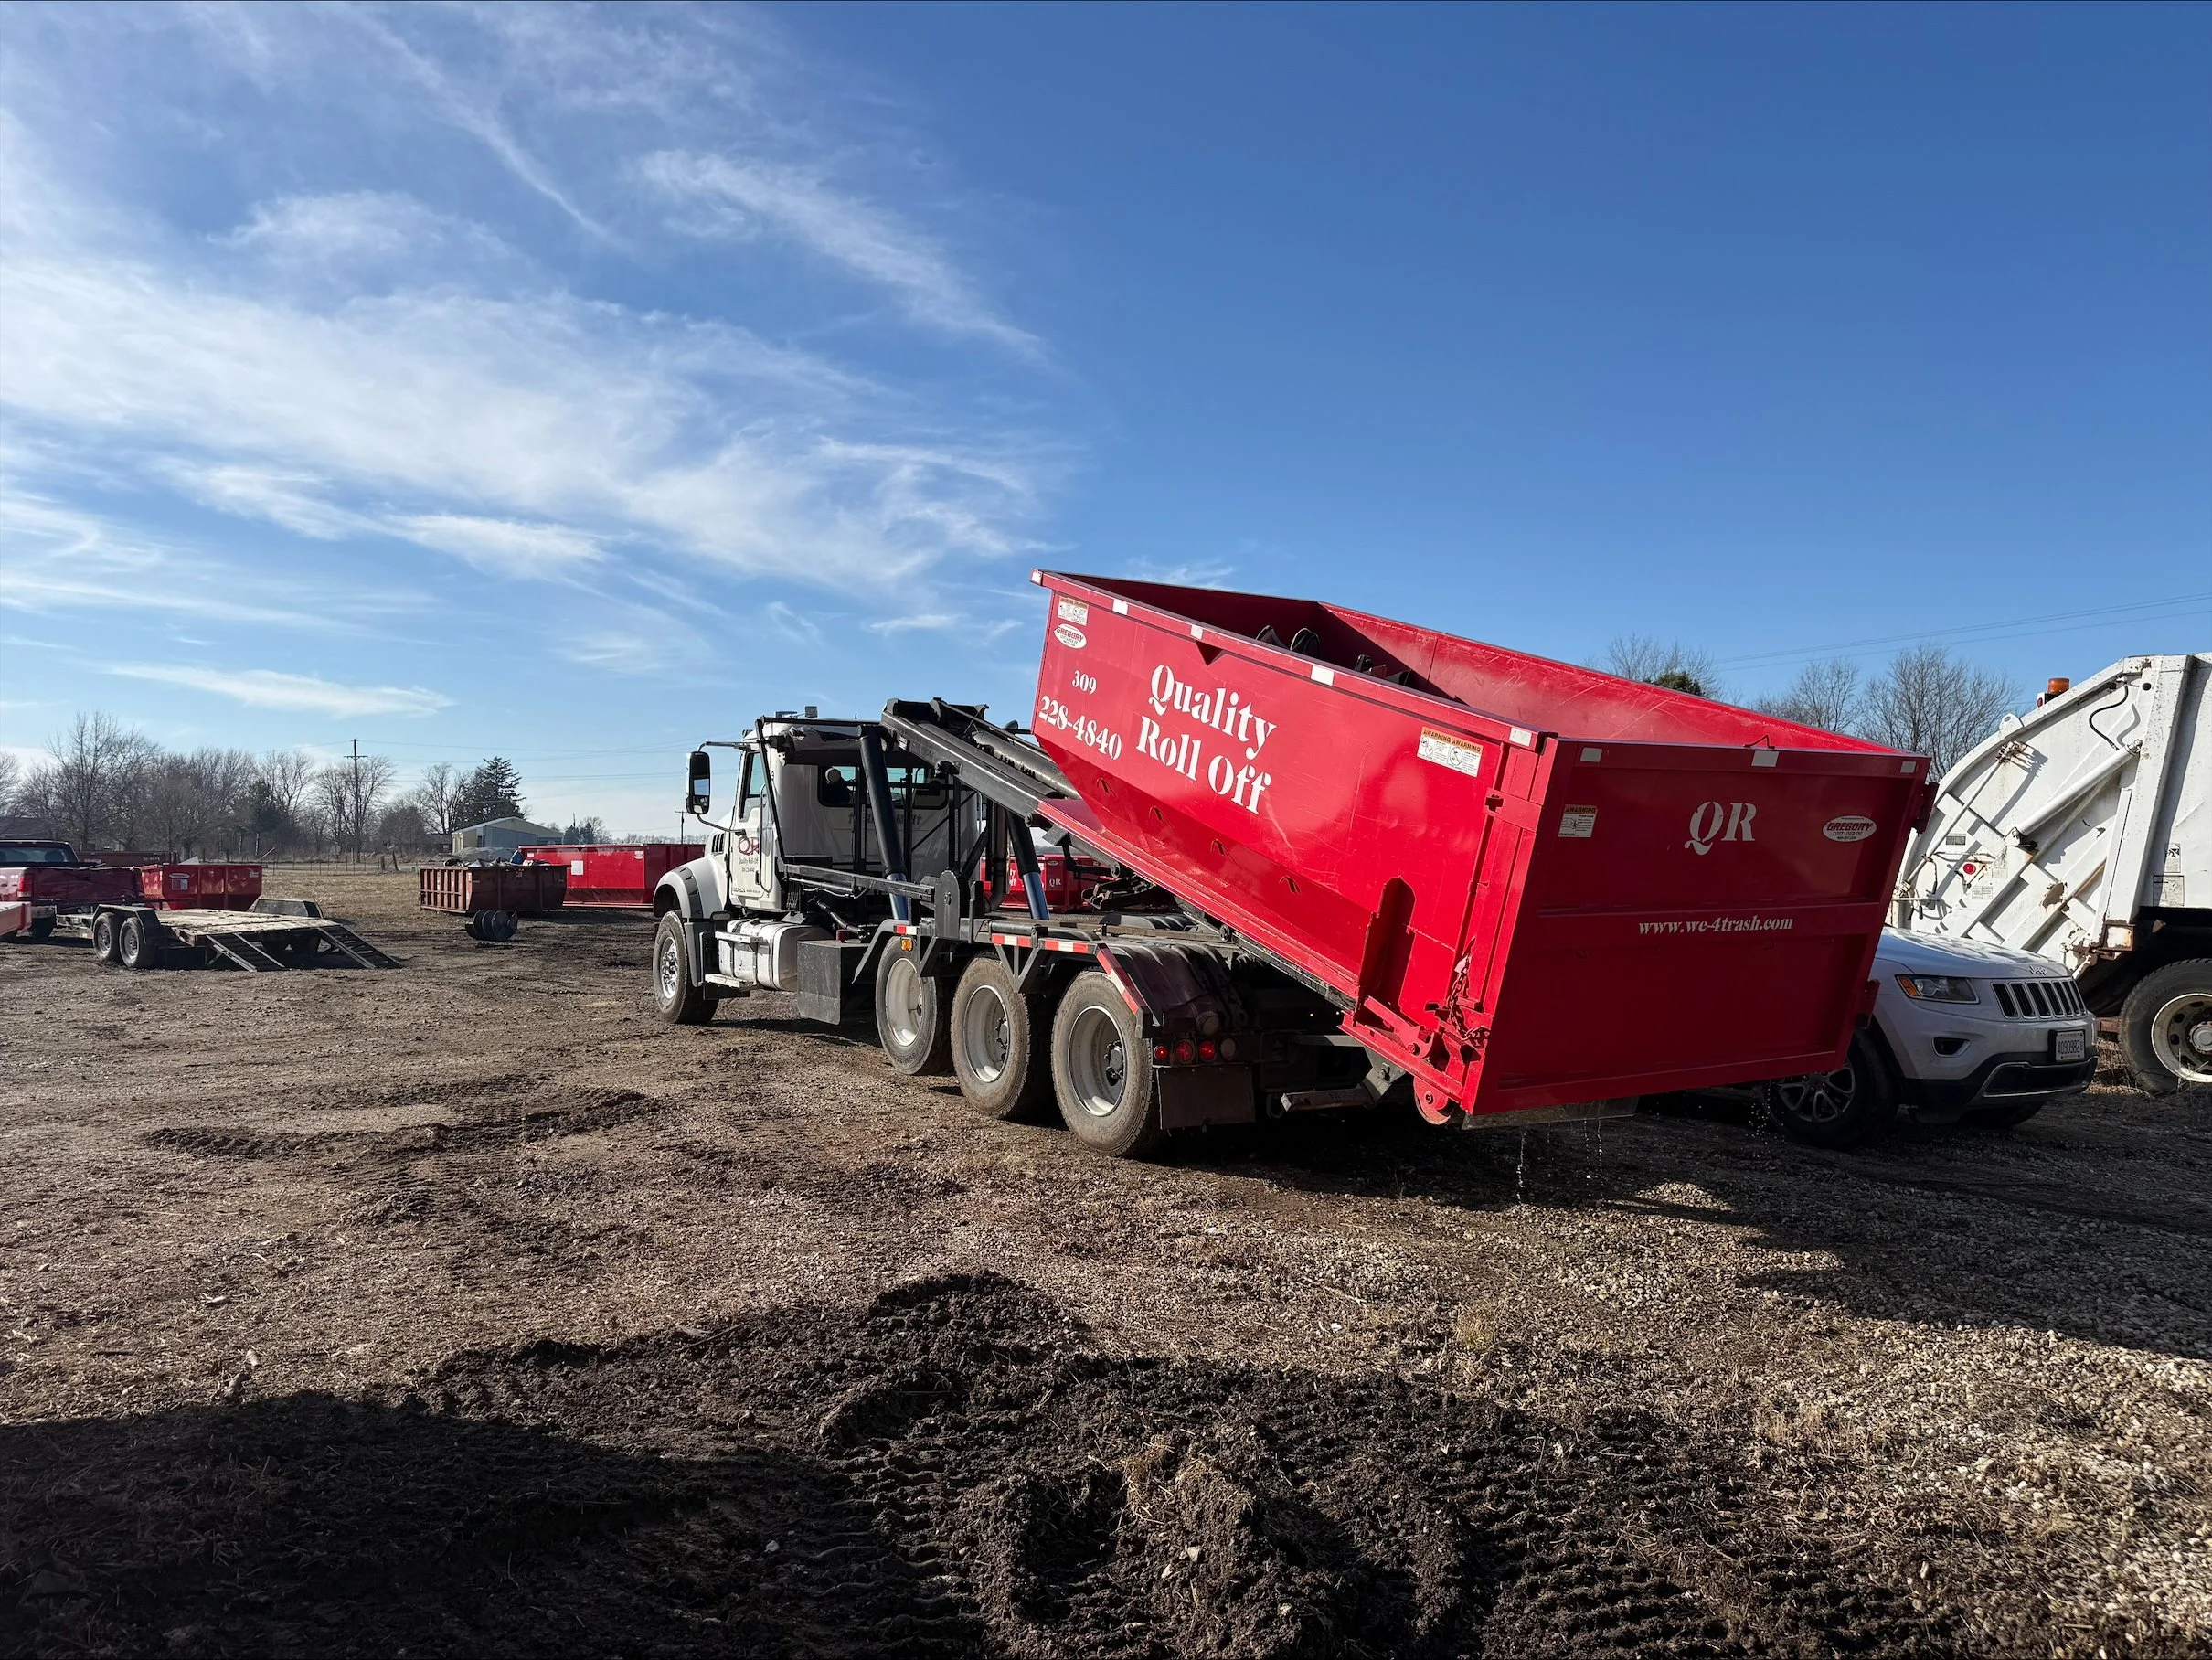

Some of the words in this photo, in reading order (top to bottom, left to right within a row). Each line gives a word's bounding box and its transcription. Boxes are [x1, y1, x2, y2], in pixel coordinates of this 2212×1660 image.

[1056, 626, 1084, 643] GREGORY
[1071, 670, 1097, 695] 309
[1148, 665, 1278, 761] Quality
[1038, 695, 1122, 761] 228-4840
[1427, 730, 1452, 743] WARNING
[1455, 740, 1481, 752] WARNING
[1135, 715, 1202, 782] Roll
[1207, 754, 1272, 815] Off
[1684, 801, 1757, 856] QR
[1826, 823, 1874, 831] GREGORY
[1048, 878, 1062, 888] QR
[1638, 914, 1793, 935] www.we-4trash.com
[2029, 965, 2047, 975] Jeep
